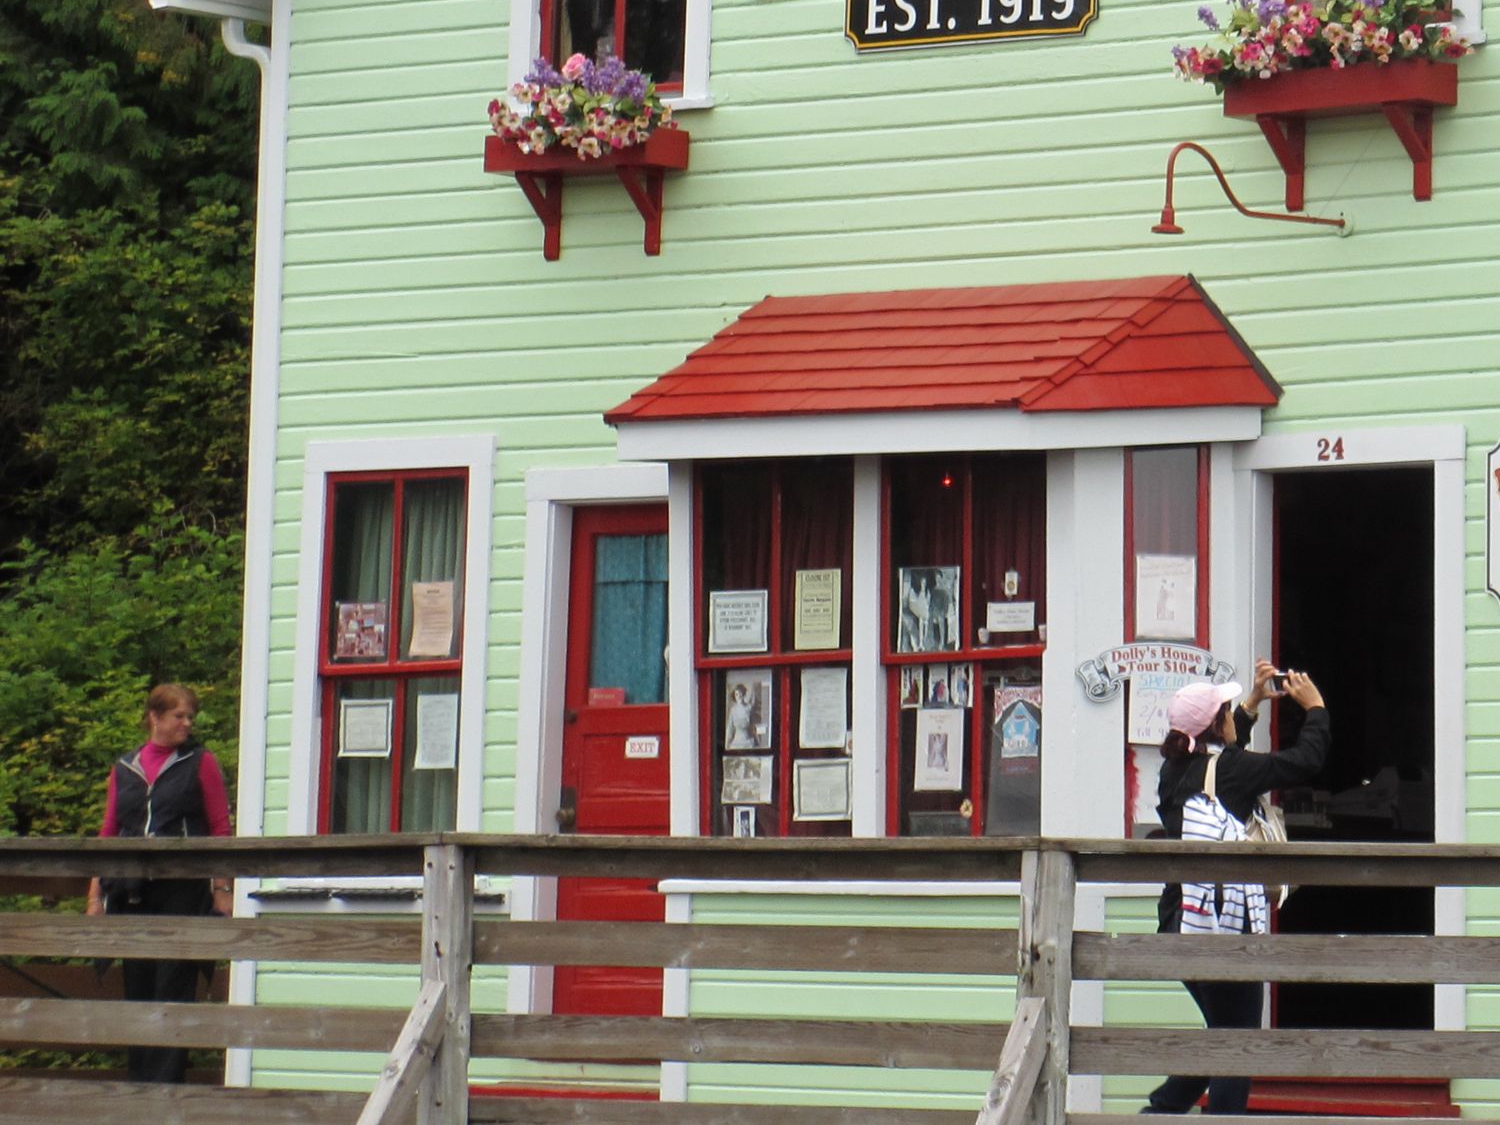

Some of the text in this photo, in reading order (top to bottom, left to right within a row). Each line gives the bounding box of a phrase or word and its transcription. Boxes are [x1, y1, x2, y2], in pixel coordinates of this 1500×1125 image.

[1317, 437, 1344, 461] 24
[1111, 646, 1202, 664] Dolly's House
[1126, 661, 1187, 675] Tour $10
[629, 742, 656, 753] EXIT
